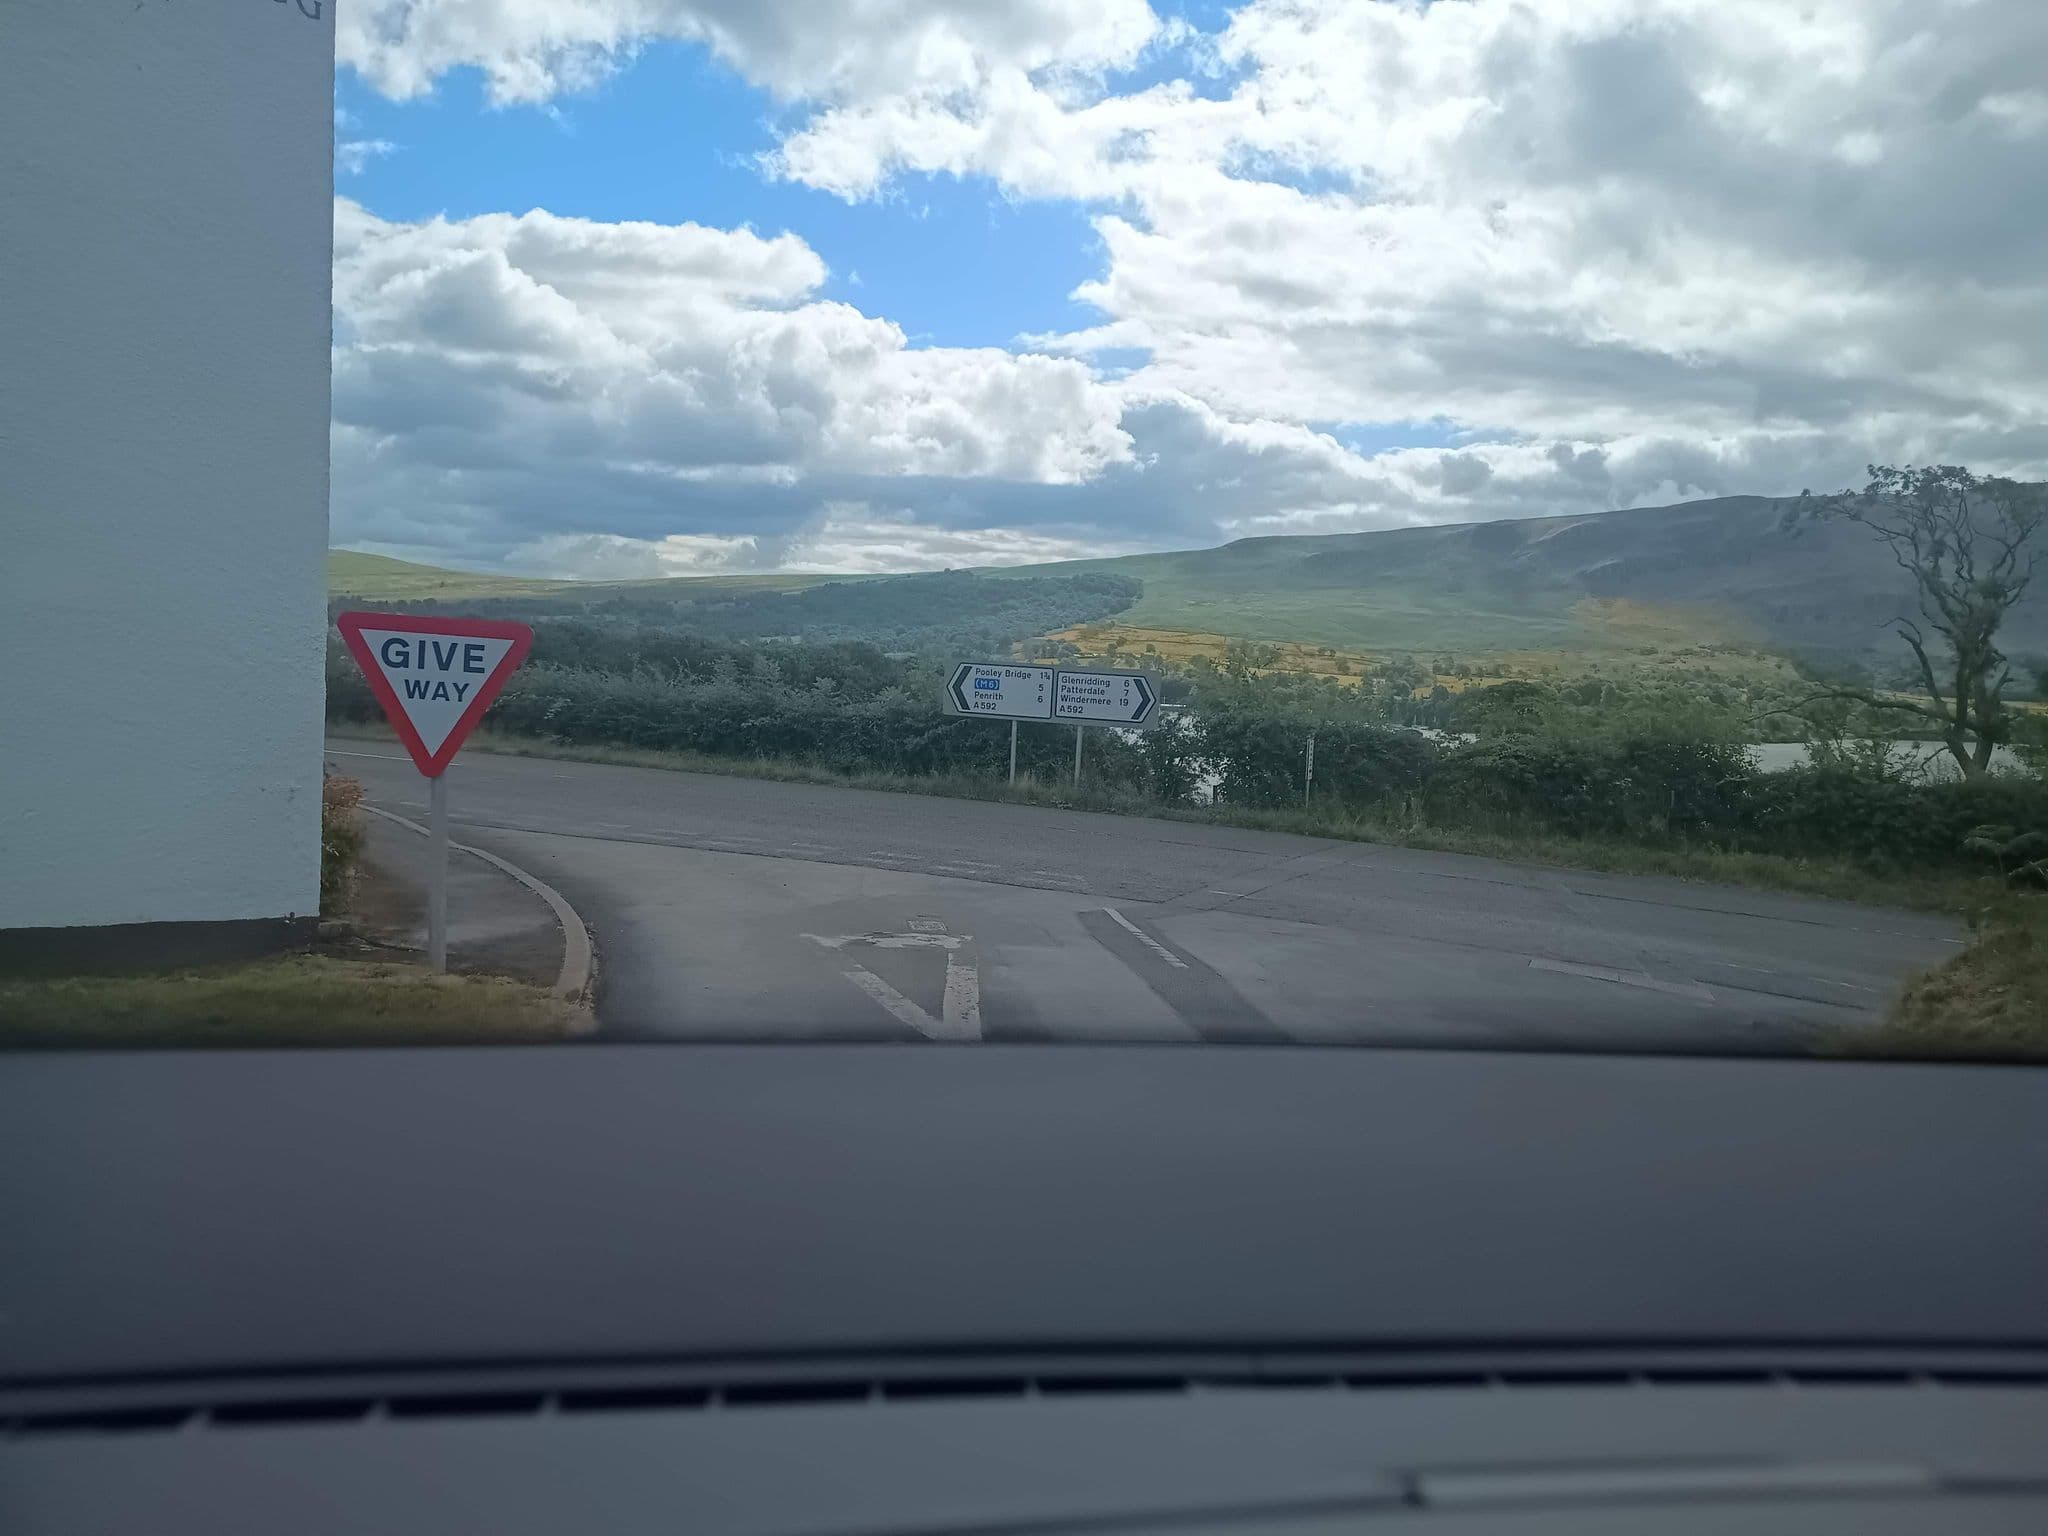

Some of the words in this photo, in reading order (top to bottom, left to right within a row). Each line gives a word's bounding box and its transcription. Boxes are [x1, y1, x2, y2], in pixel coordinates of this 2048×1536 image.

[381, 637, 486, 674] GIVE
[975, 668, 1002, 678] Pooley
[1005, 669, 1032, 680] Bridge
[975, 679, 999, 689] (M6)
[1061, 676, 1111, 687] Glenridding
[404, 679, 470, 702] WAY
[1061, 685, 1105, 695] Patterdale
[1124, 689, 1129, 697] 7
[974, 691, 1003, 700] Penrith
[1037, 695, 1043, 703] 6
[1060, 695, 1112, 705] Windermere
[1119, 698, 1129, 706] 19
